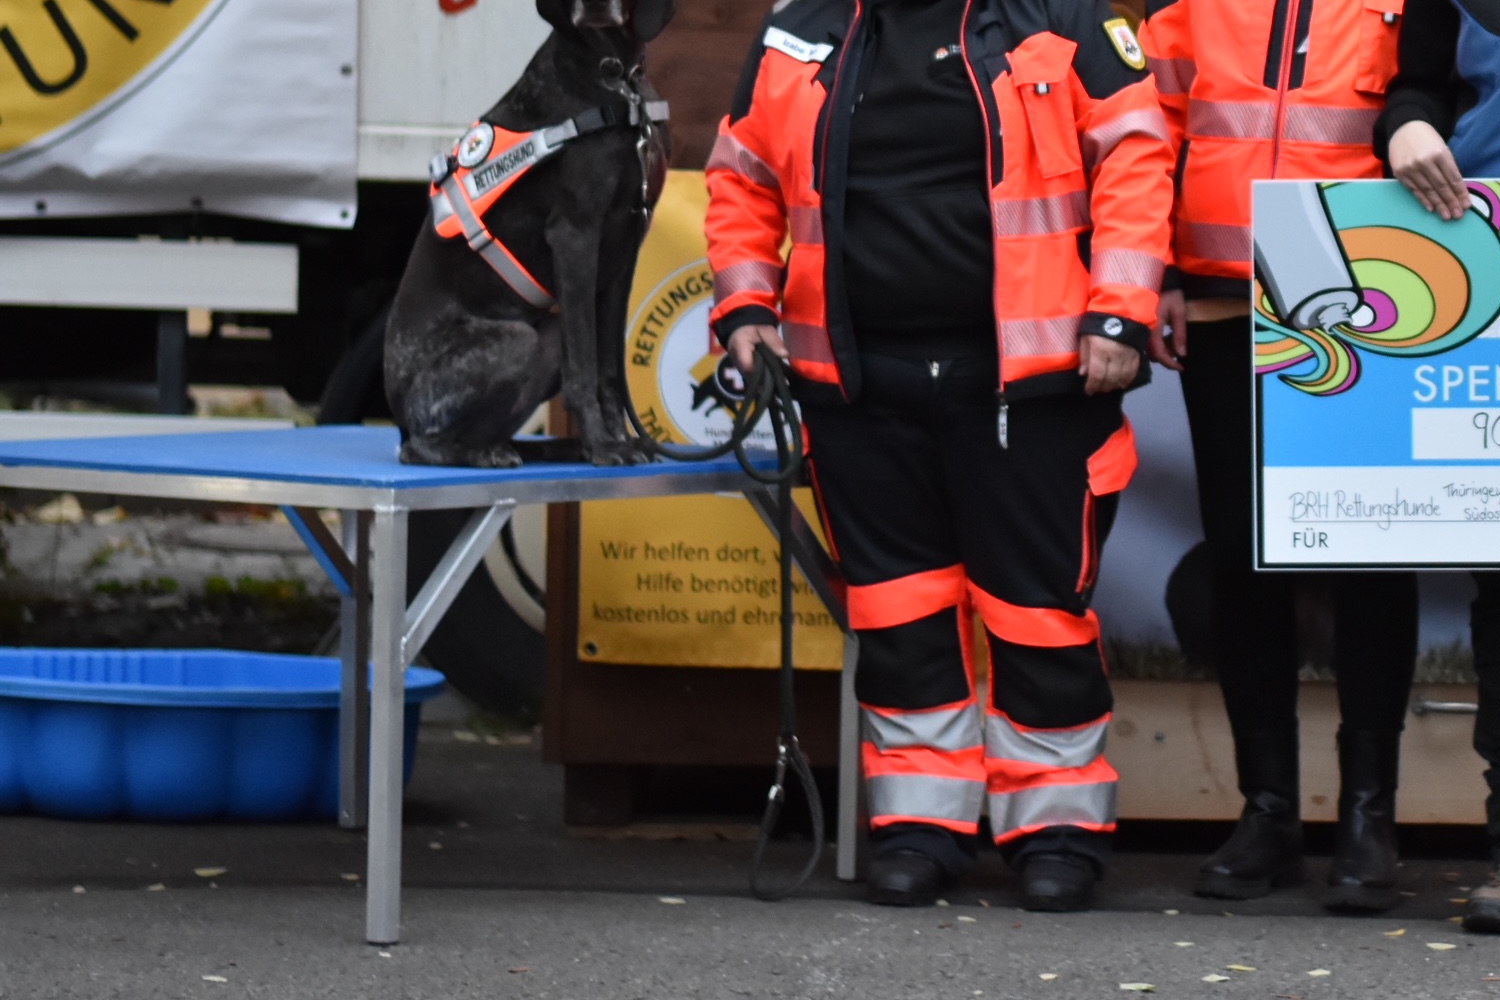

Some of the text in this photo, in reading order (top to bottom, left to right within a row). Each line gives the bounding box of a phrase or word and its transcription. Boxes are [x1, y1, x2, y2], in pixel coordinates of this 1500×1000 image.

[472, 140, 535, 191] RETTUNGSHUND
[1288, 490, 1329, 520] BRH
[1333, 487, 1442, 531] Rettungshunde
[1292, 527, 1329, 549] FÜR
[600, 541, 637, 562] Wir
[644, 541, 709, 562] helfen
[715, 542, 766, 565] dort,
[637, 573, 684, 593] Hilfe
[691, 573, 779, 598] benötigt
[592, 602, 690, 625] kostenlos
[696, 605, 737, 626] und
